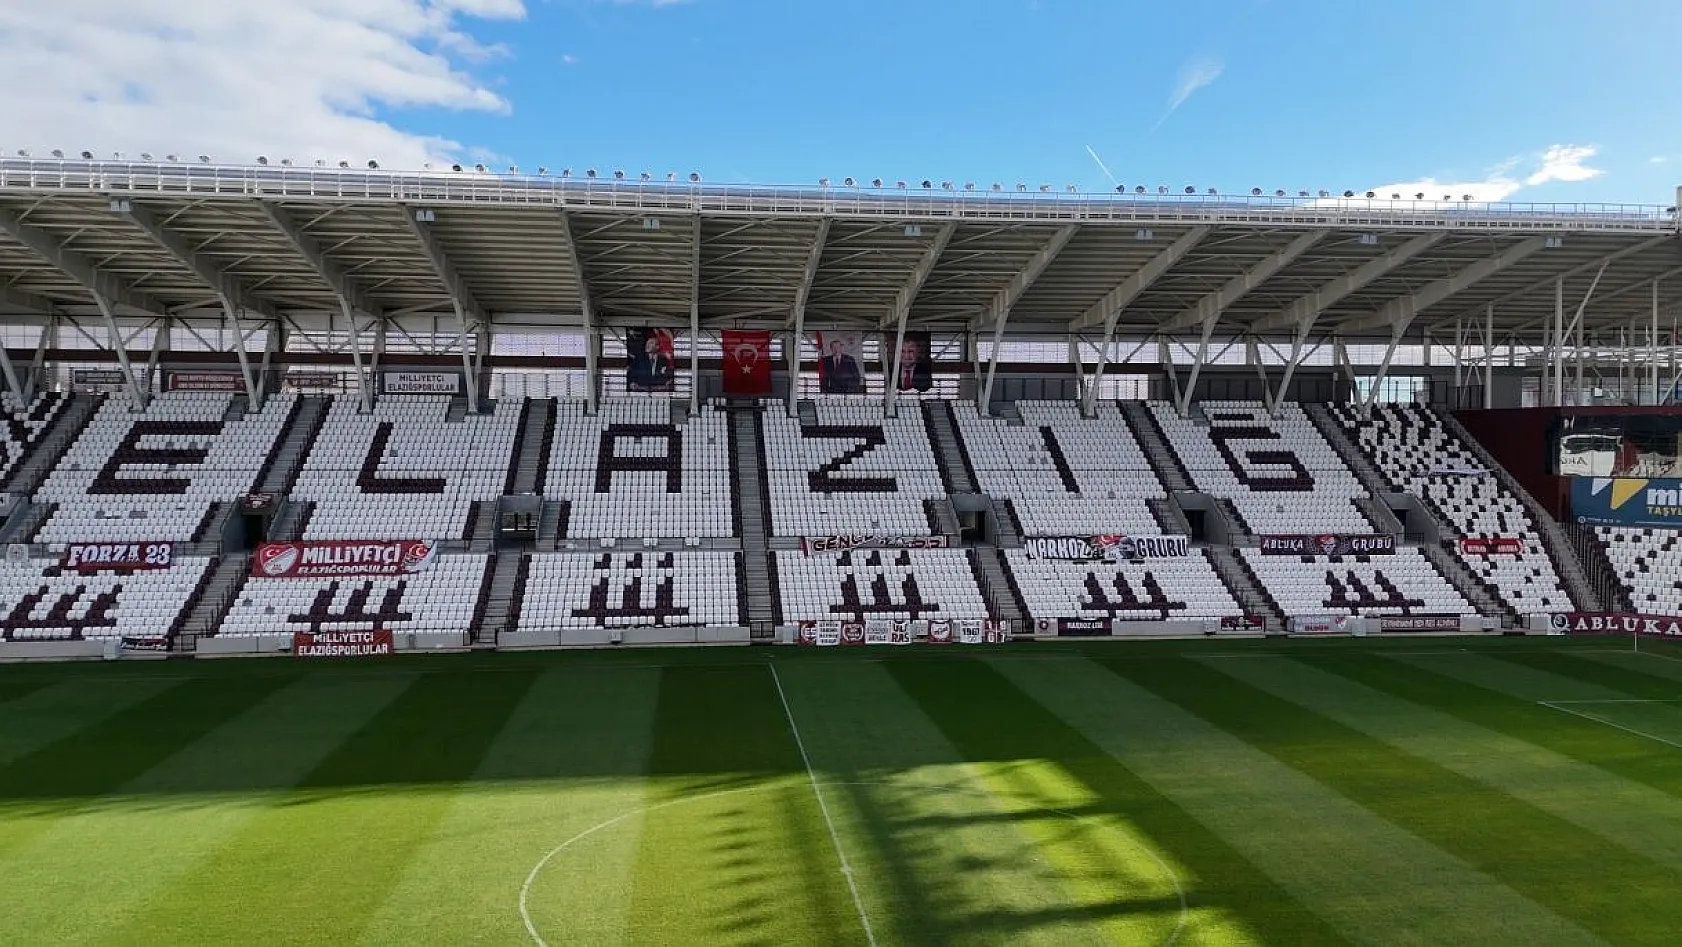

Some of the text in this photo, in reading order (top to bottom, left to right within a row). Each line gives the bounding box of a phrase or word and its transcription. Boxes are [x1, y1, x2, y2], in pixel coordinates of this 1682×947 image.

[67, 543, 171, 566] FORZA 23
[1026, 538, 1092, 559] NARKOZ
[1136, 538, 1188, 558] GRUBU
[1263, 539, 1304, 550] ABLUKA
[1352, 538, 1392, 551] GRUBU
[1574, 616, 1682, 636] ABLUKA
